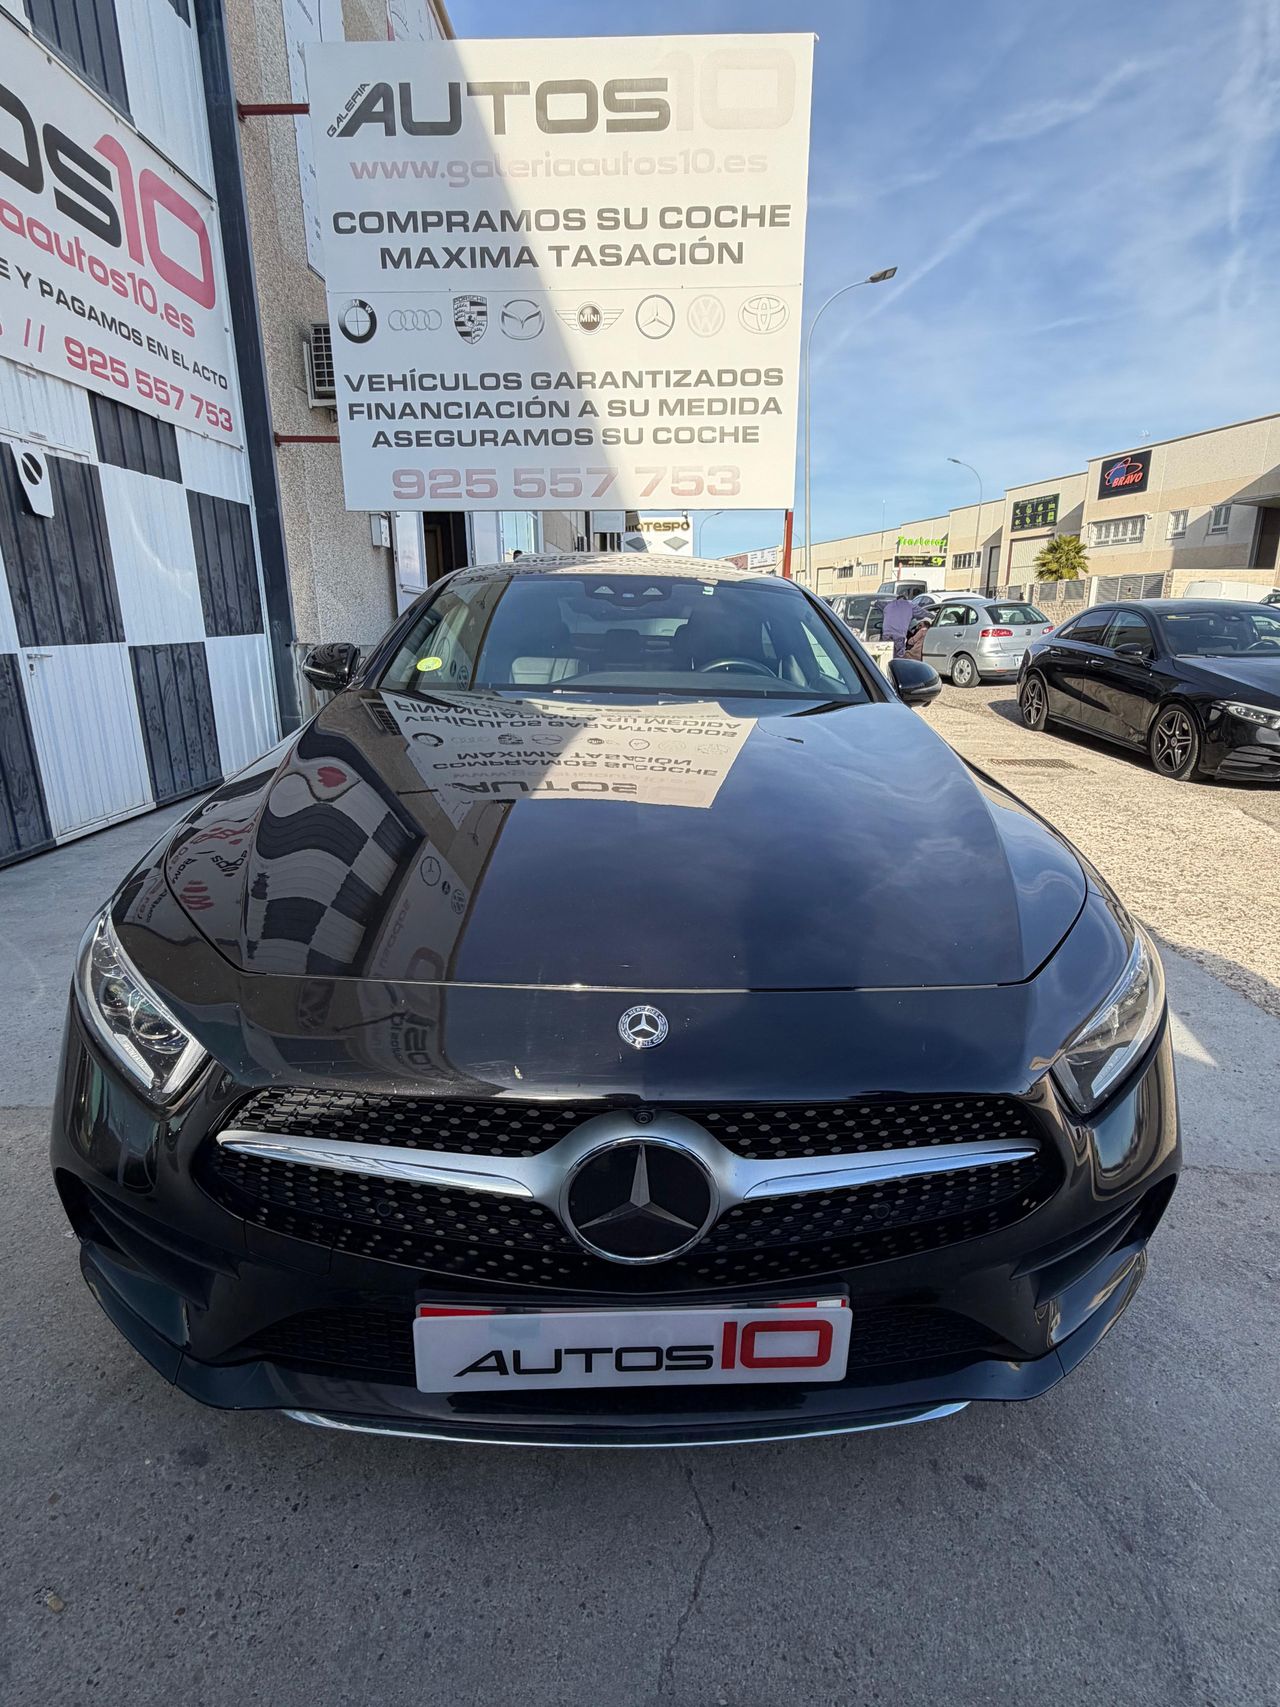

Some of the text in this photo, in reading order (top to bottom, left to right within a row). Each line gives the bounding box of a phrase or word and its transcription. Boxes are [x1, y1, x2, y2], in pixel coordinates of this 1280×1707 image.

[326, 82, 371, 138] GALERIA
[349, 148, 769, 188] www.galeriaautos10.es
[332, 204, 792, 235] COMPRAMOS SU COCHE
[380, 235, 744, 270] MAXIMA TASACIÓN
[15, 264, 32, 290] Y
[38, 277, 143, 347] PAGAMOS
[146, 336, 169, 361] EN
[171, 348, 190, 371] EL
[192, 361, 228, 391] ACTO
[579, 313, 600, 323] MINI
[64, 335, 130, 389] 925
[135, 367, 185, 411] 557
[190, 393, 233, 431] 753
[344, 366, 784, 393] VEHÍCULOS GARANTIZADOS
[348, 395, 783, 421] FINANCIACIÓN A SU MEDIDA
[371, 425, 760, 449] ASEGURAMOS SU COCHE
[391, 464, 741, 500] 925 557 753
[1112, 471, 1143, 487] BRAVO
[628, 1007, 660, 1017] MERCDES
[453, 1319, 834, 1378] AUTOS10
